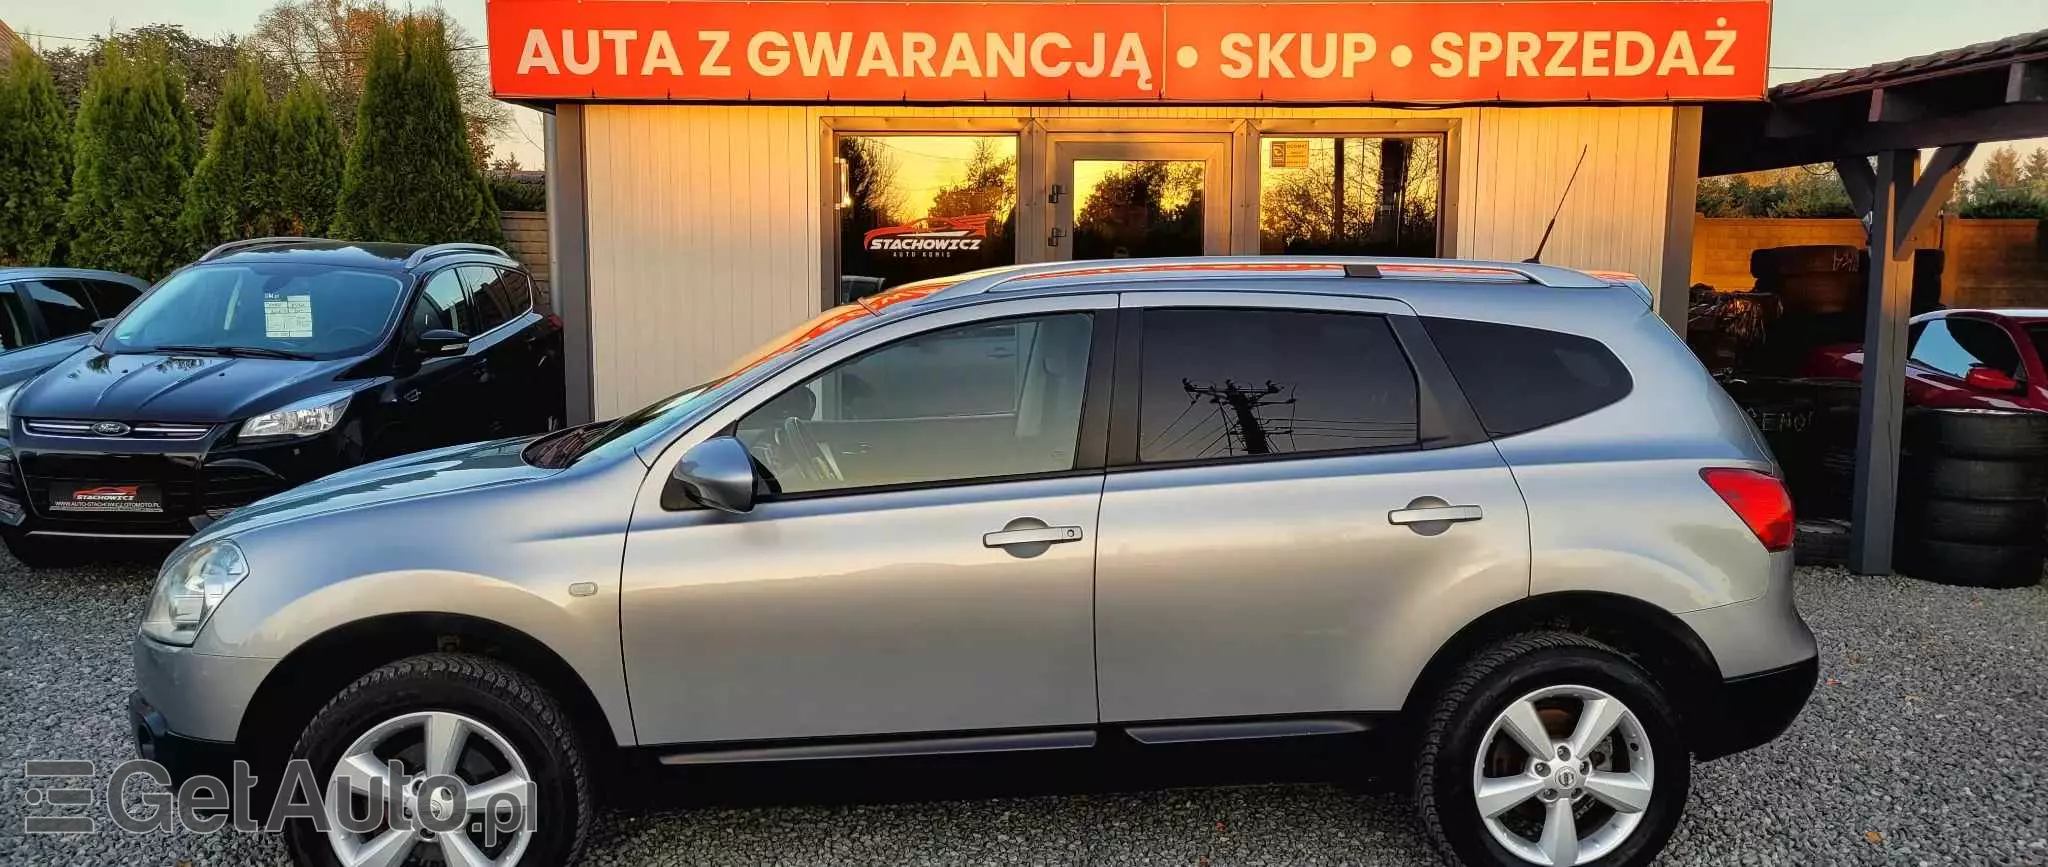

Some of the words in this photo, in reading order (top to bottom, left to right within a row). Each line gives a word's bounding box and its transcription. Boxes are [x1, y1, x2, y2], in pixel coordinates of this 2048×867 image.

[517, 29, 683, 75] AUTA
[698, 30, 731, 76] Z
[746, 31, 1152, 90] GWARANCJĄ
[1219, 33, 1377, 79] SKUP
[1430, 17, 1738, 78] SPRZEDAŻ
[870, 239, 982, 250] STACHOWICZ
